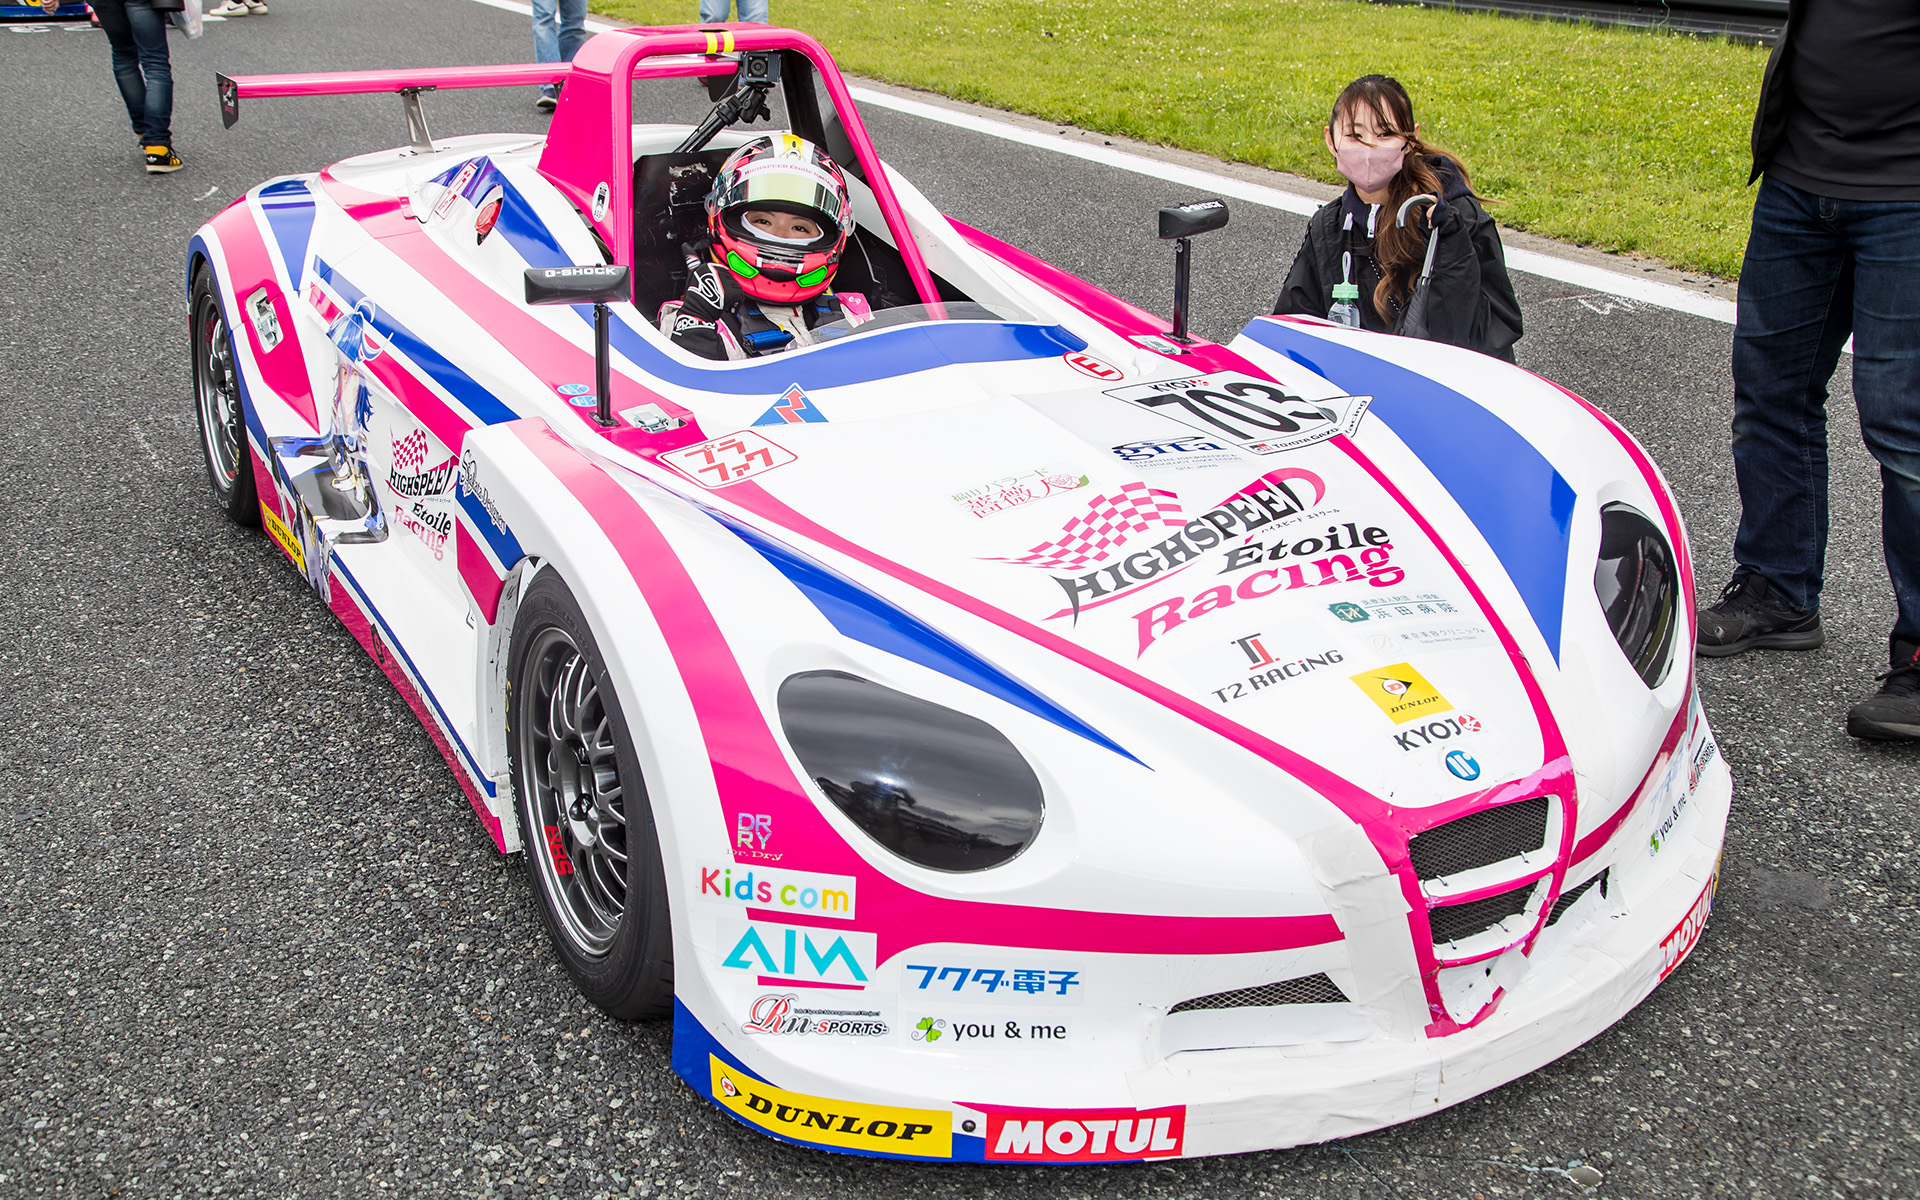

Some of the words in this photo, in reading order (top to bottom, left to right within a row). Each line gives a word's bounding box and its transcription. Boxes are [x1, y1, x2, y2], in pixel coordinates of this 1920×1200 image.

[544, 267, 617, 278] G-SHOCK
[1134, 382, 1338, 441] 703
[1273, 437, 1311, 449] TOYOTA
[393, 504, 448, 562] Racing
[411, 498, 452, 537] Étoile
[270, 518, 302, 558] DUNLOP
[1048, 467, 1326, 629] HIGHSPEED
[1216, 522, 1391, 575] Étoile
[1131, 543, 1405, 661] Racing
[1371, 602, 1459, 619] 浜田病院
[1211, 682, 1248, 704] T2
[1390, 696, 1440, 714] DUNLOP
[544, 825, 574, 876] BBS
[751, 850, 784, 861] Dry
[701, 866, 772, 903] Kids
[780, 884, 849, 912] com
[906, 965, 1080, 996] フクダ電子
[952, 1022, 995, 1041] you
[1004, 1020, 1023, 1039] &
[1030, 1024, 1067, 1039] me
[745, 1092, 933, 1142] DUNLOP
[994, 1117, 1178, 1155] MOTUL
